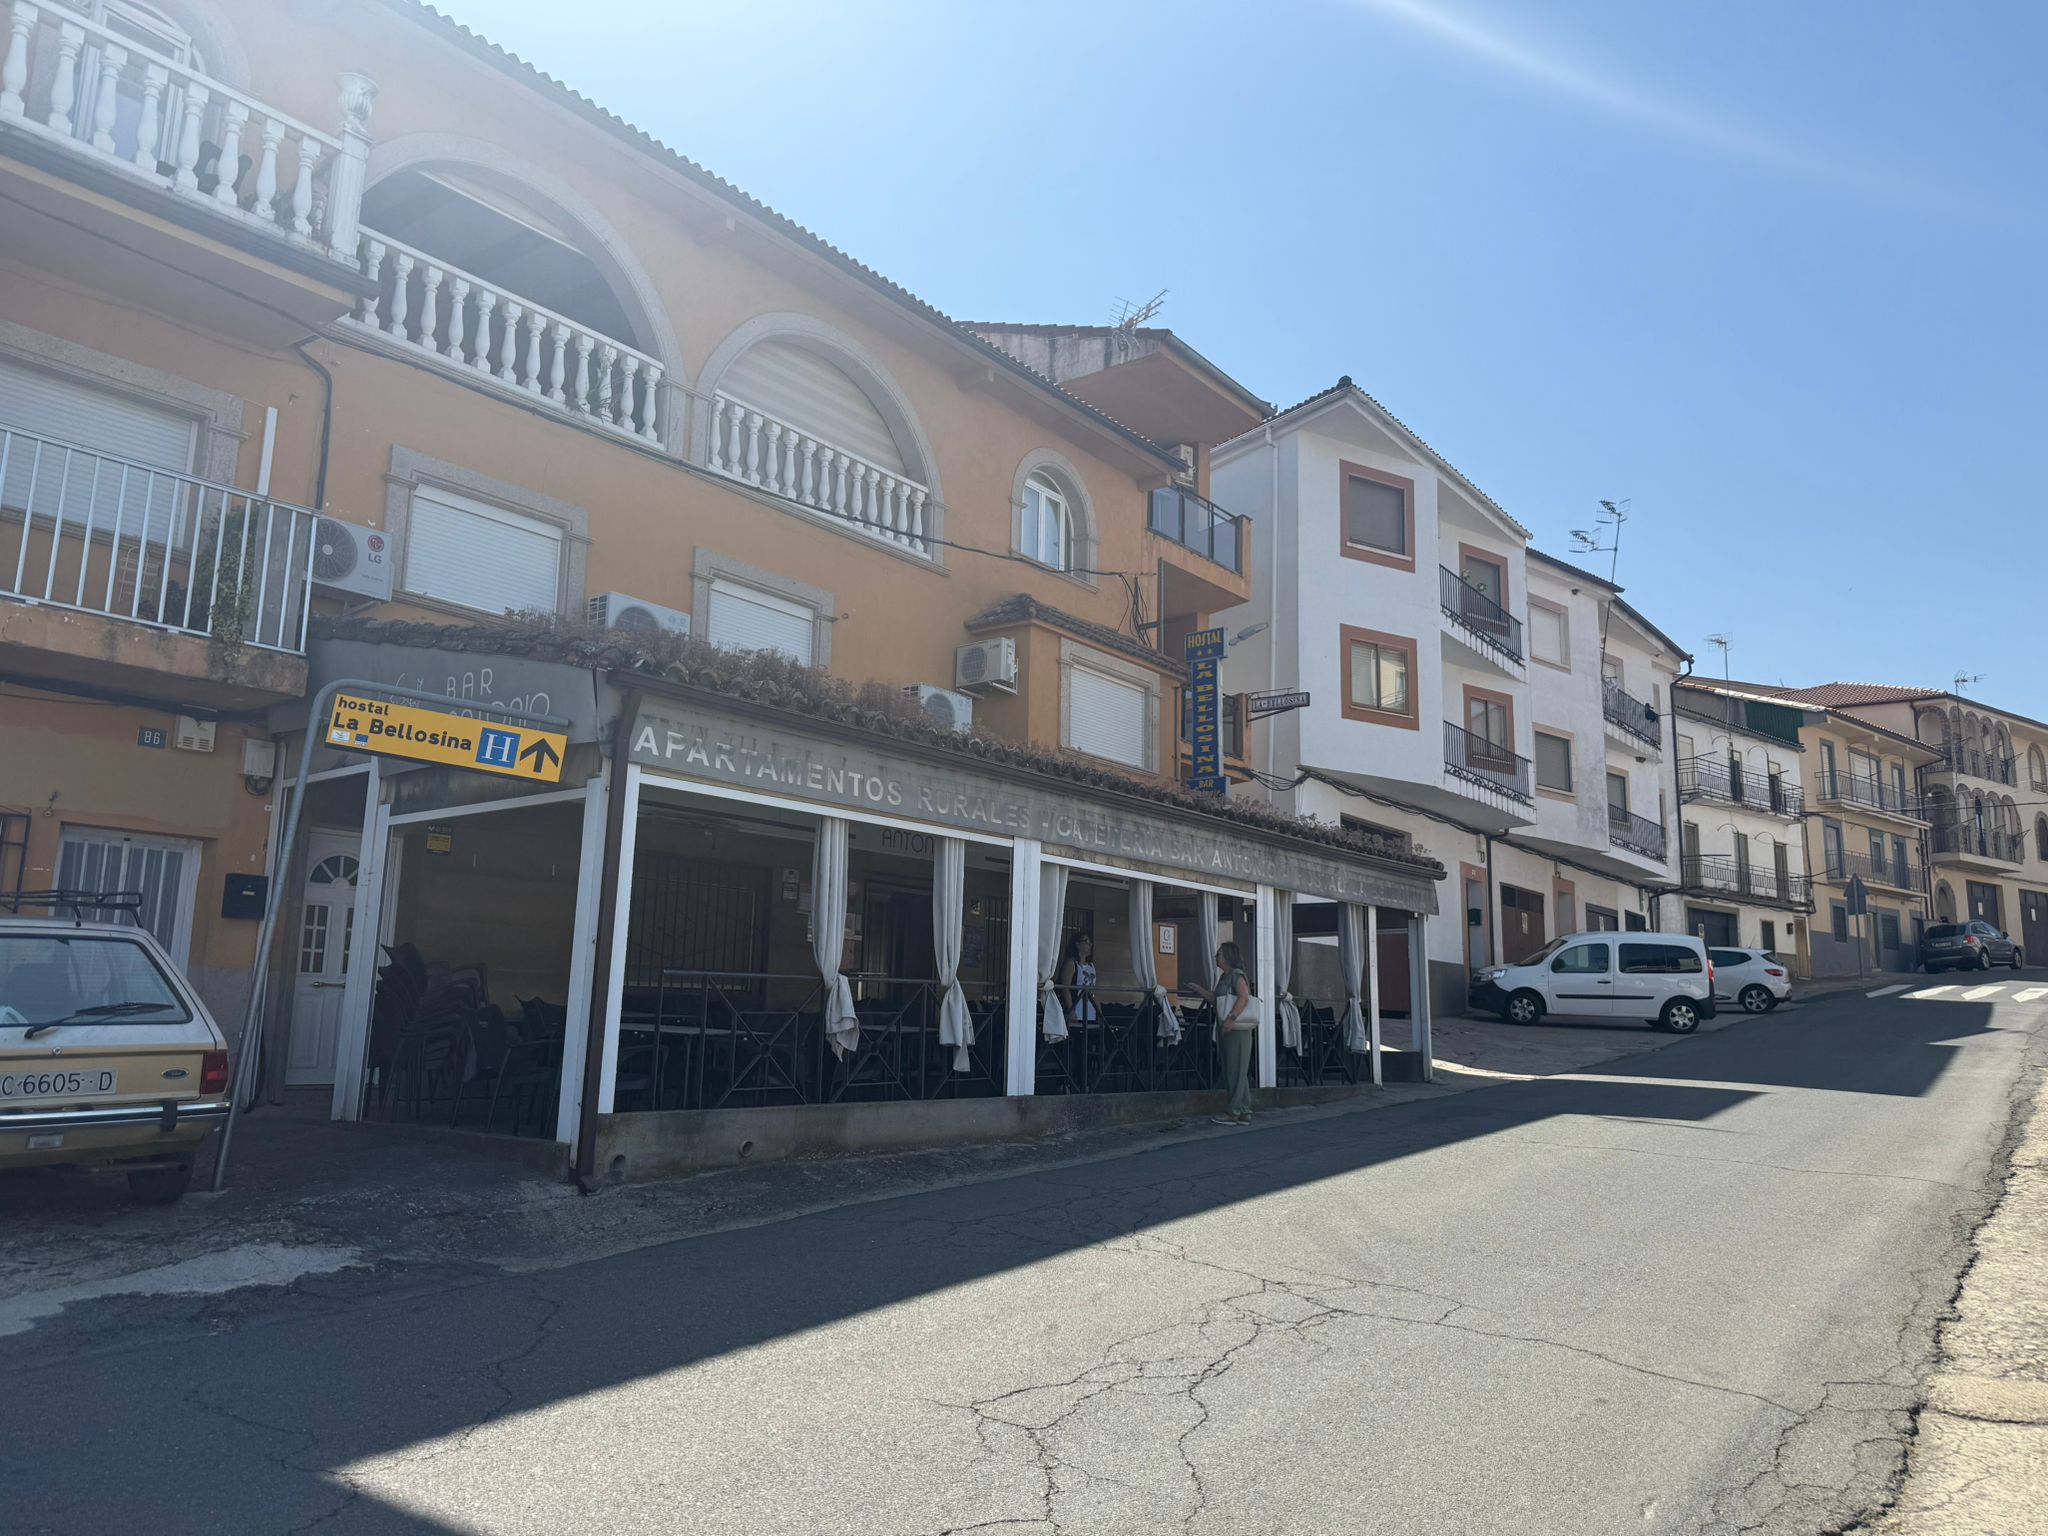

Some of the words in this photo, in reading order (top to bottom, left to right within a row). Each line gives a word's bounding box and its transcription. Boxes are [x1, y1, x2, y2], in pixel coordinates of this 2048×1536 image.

[368, 552, 382, 564] LG
[1187, 631, 1222, 649] HOSTAL
[446, 668, 493, 700] BAR
[338, 697, 389, 716] hostal
[144, 731, 160, 744] 86
[333, 712, 359, 731] La
[369, 718, 472, 751] Bellosina
[1195, 684, 1215, 773] BELLOSINA
[481, 733, 515, 763] H
[634, 726, 902, 806] APARTAMENTOS
[917, 788, 1030, 829] RURALES
